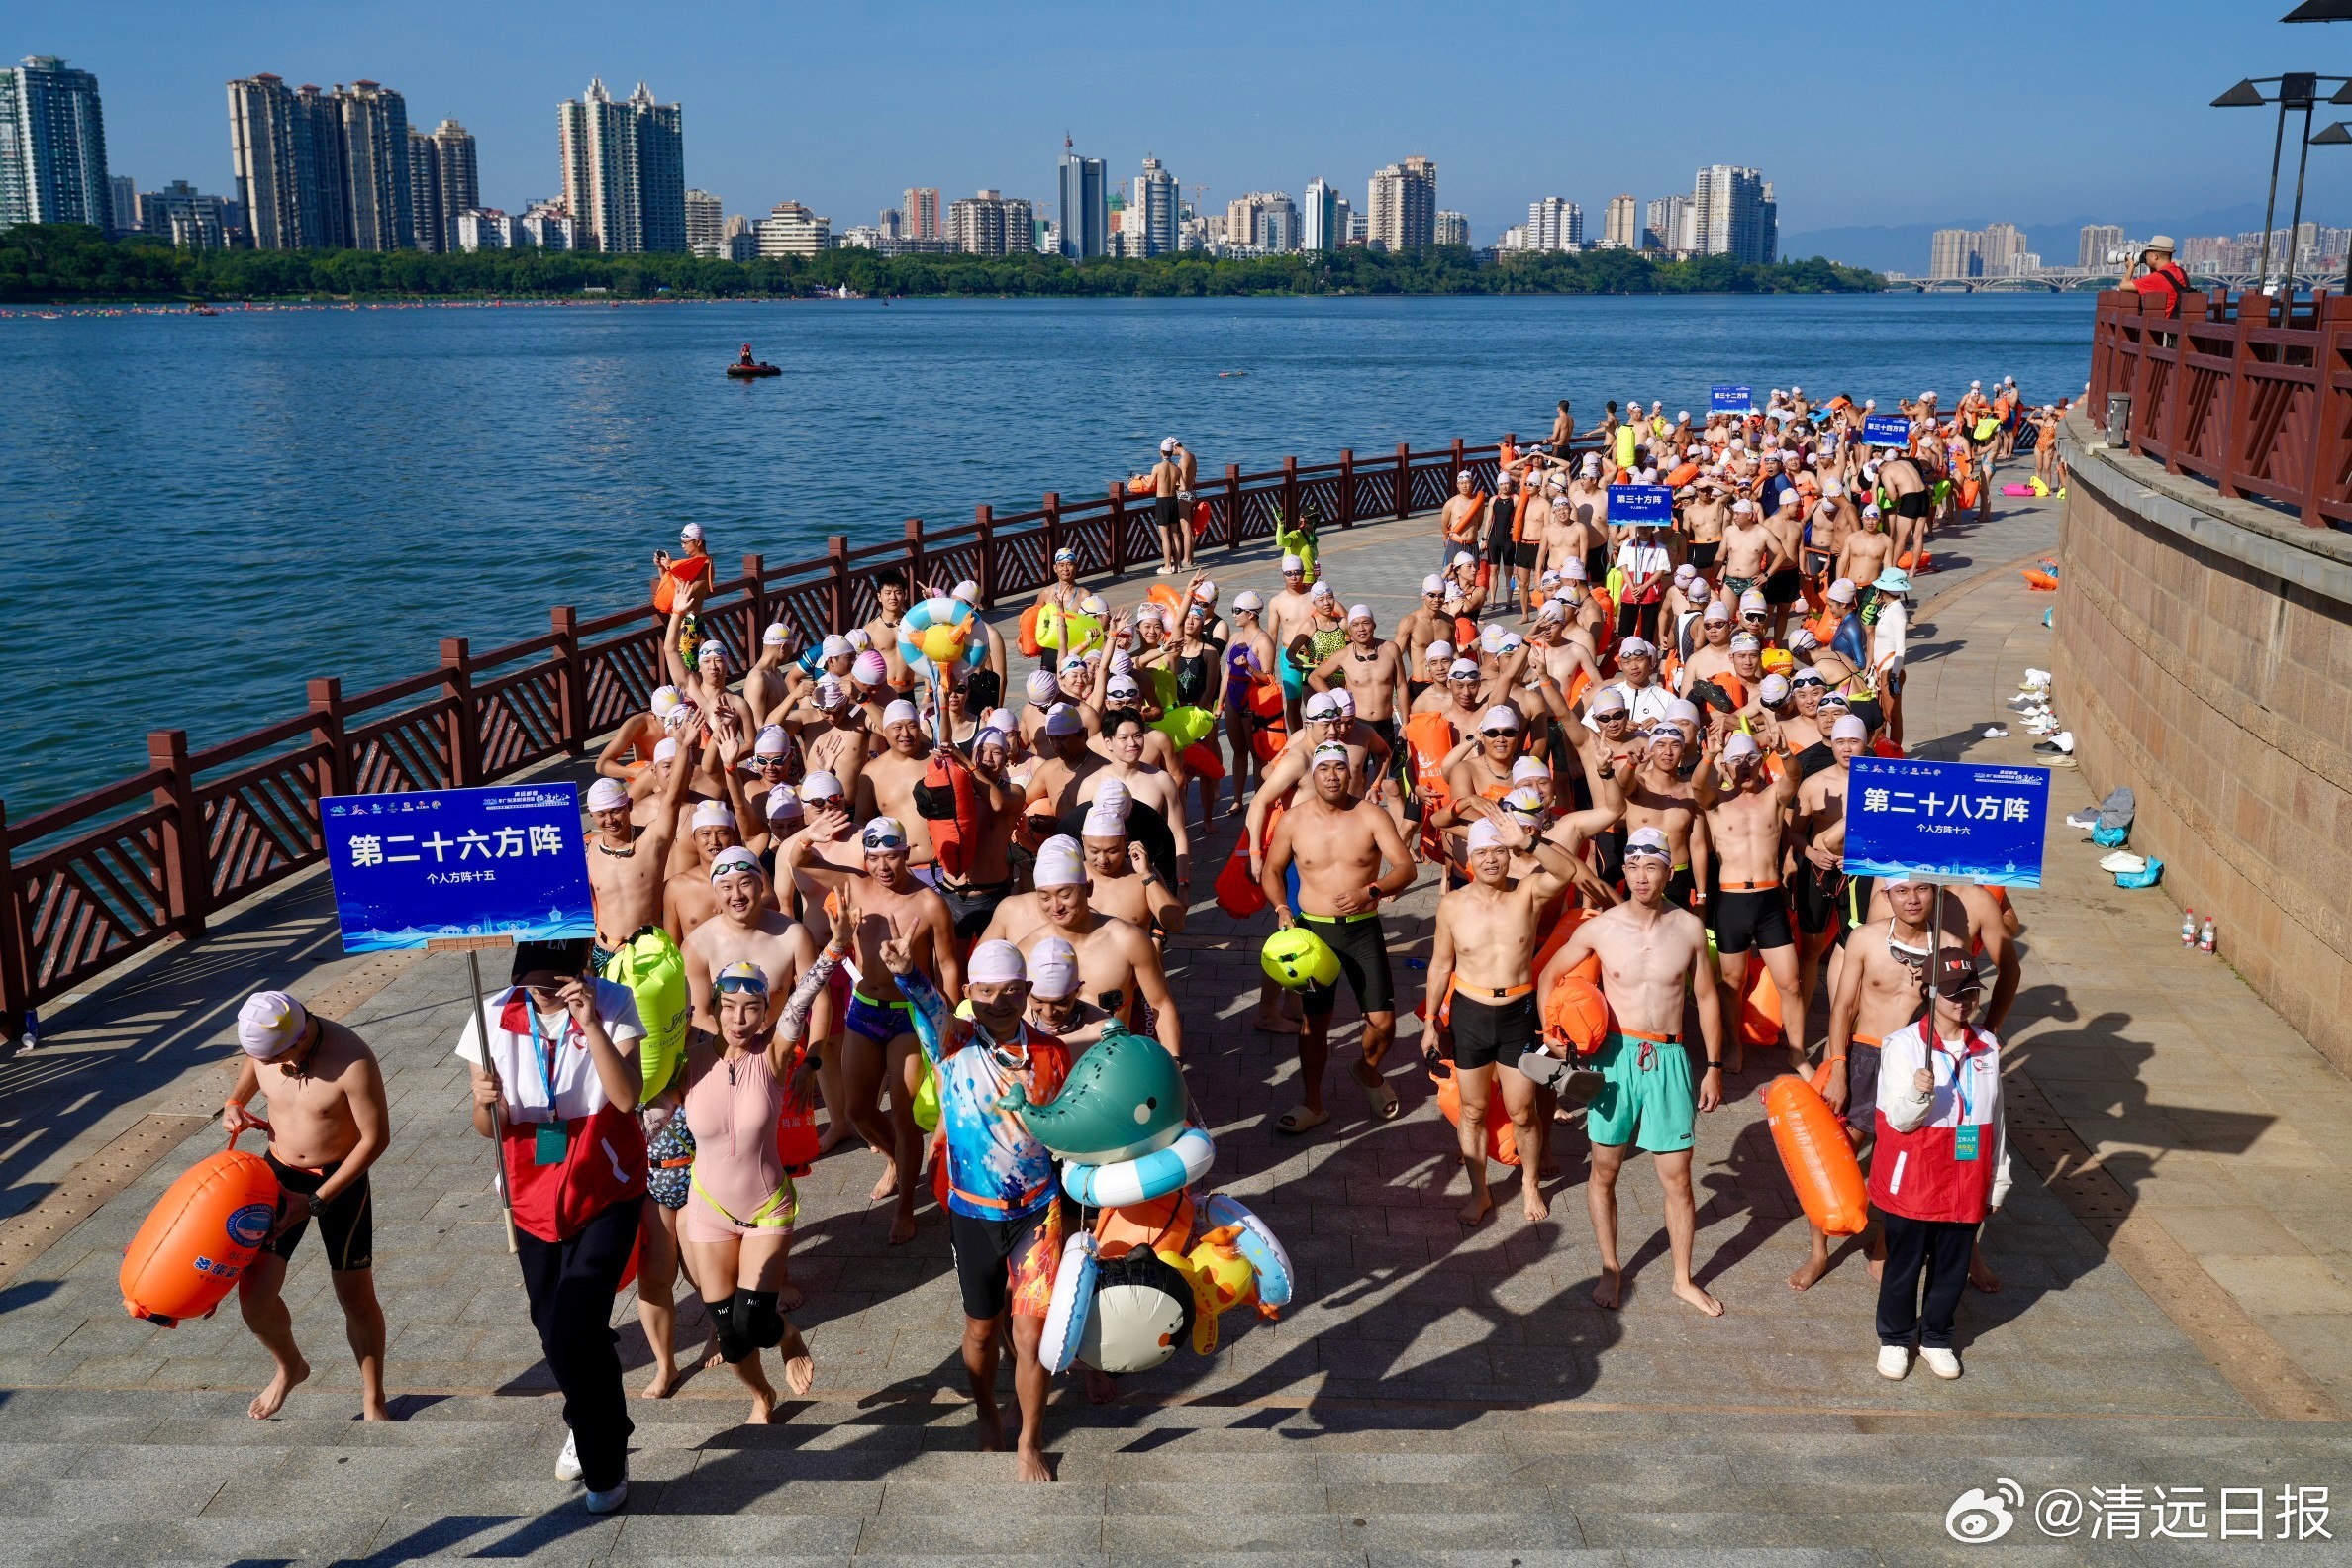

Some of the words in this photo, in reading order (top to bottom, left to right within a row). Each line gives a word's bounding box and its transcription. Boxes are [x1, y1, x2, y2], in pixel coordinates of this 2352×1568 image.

[1867, 422, 1906, 433] 第三十四方阵
[1617, 494, 1662, 505] 第三十方阵
[1863, 787, 2030, 823] 第二十八方阵
[1916, 824, 1971, 835] 个人方阵十六
[347, 823, 564, 868] 第二十六方阵
[426, 870, 496, 885] 个人方阵十五
